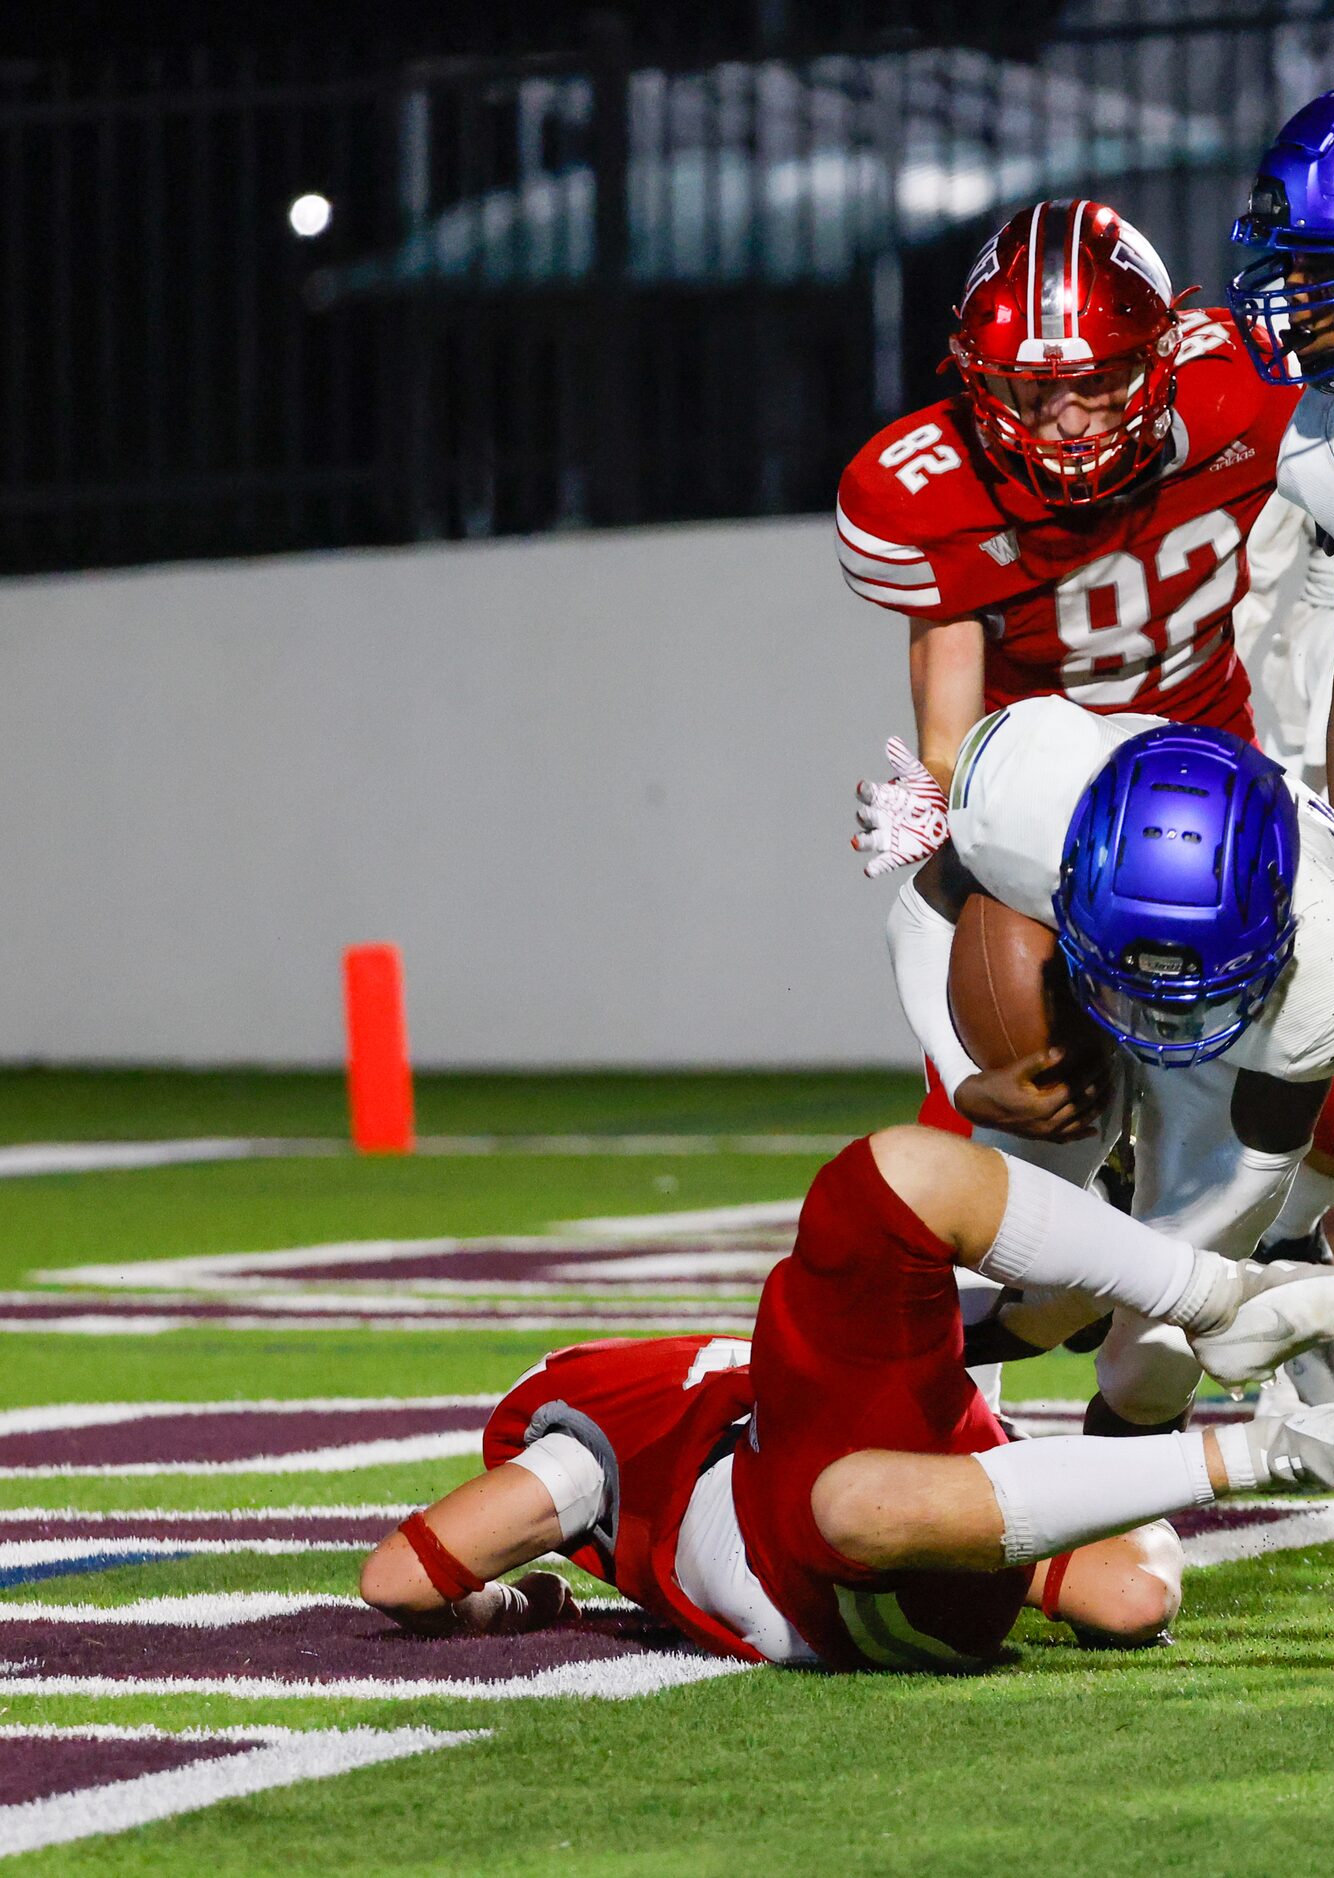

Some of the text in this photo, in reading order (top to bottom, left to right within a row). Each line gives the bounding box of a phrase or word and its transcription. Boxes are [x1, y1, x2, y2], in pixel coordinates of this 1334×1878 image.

[878, 422, 962, 496] 82
[1208, 448, 1257, 473] adidas
[978, 526, 1021, 567] W
[1055, 508, 1242, 706] 82
